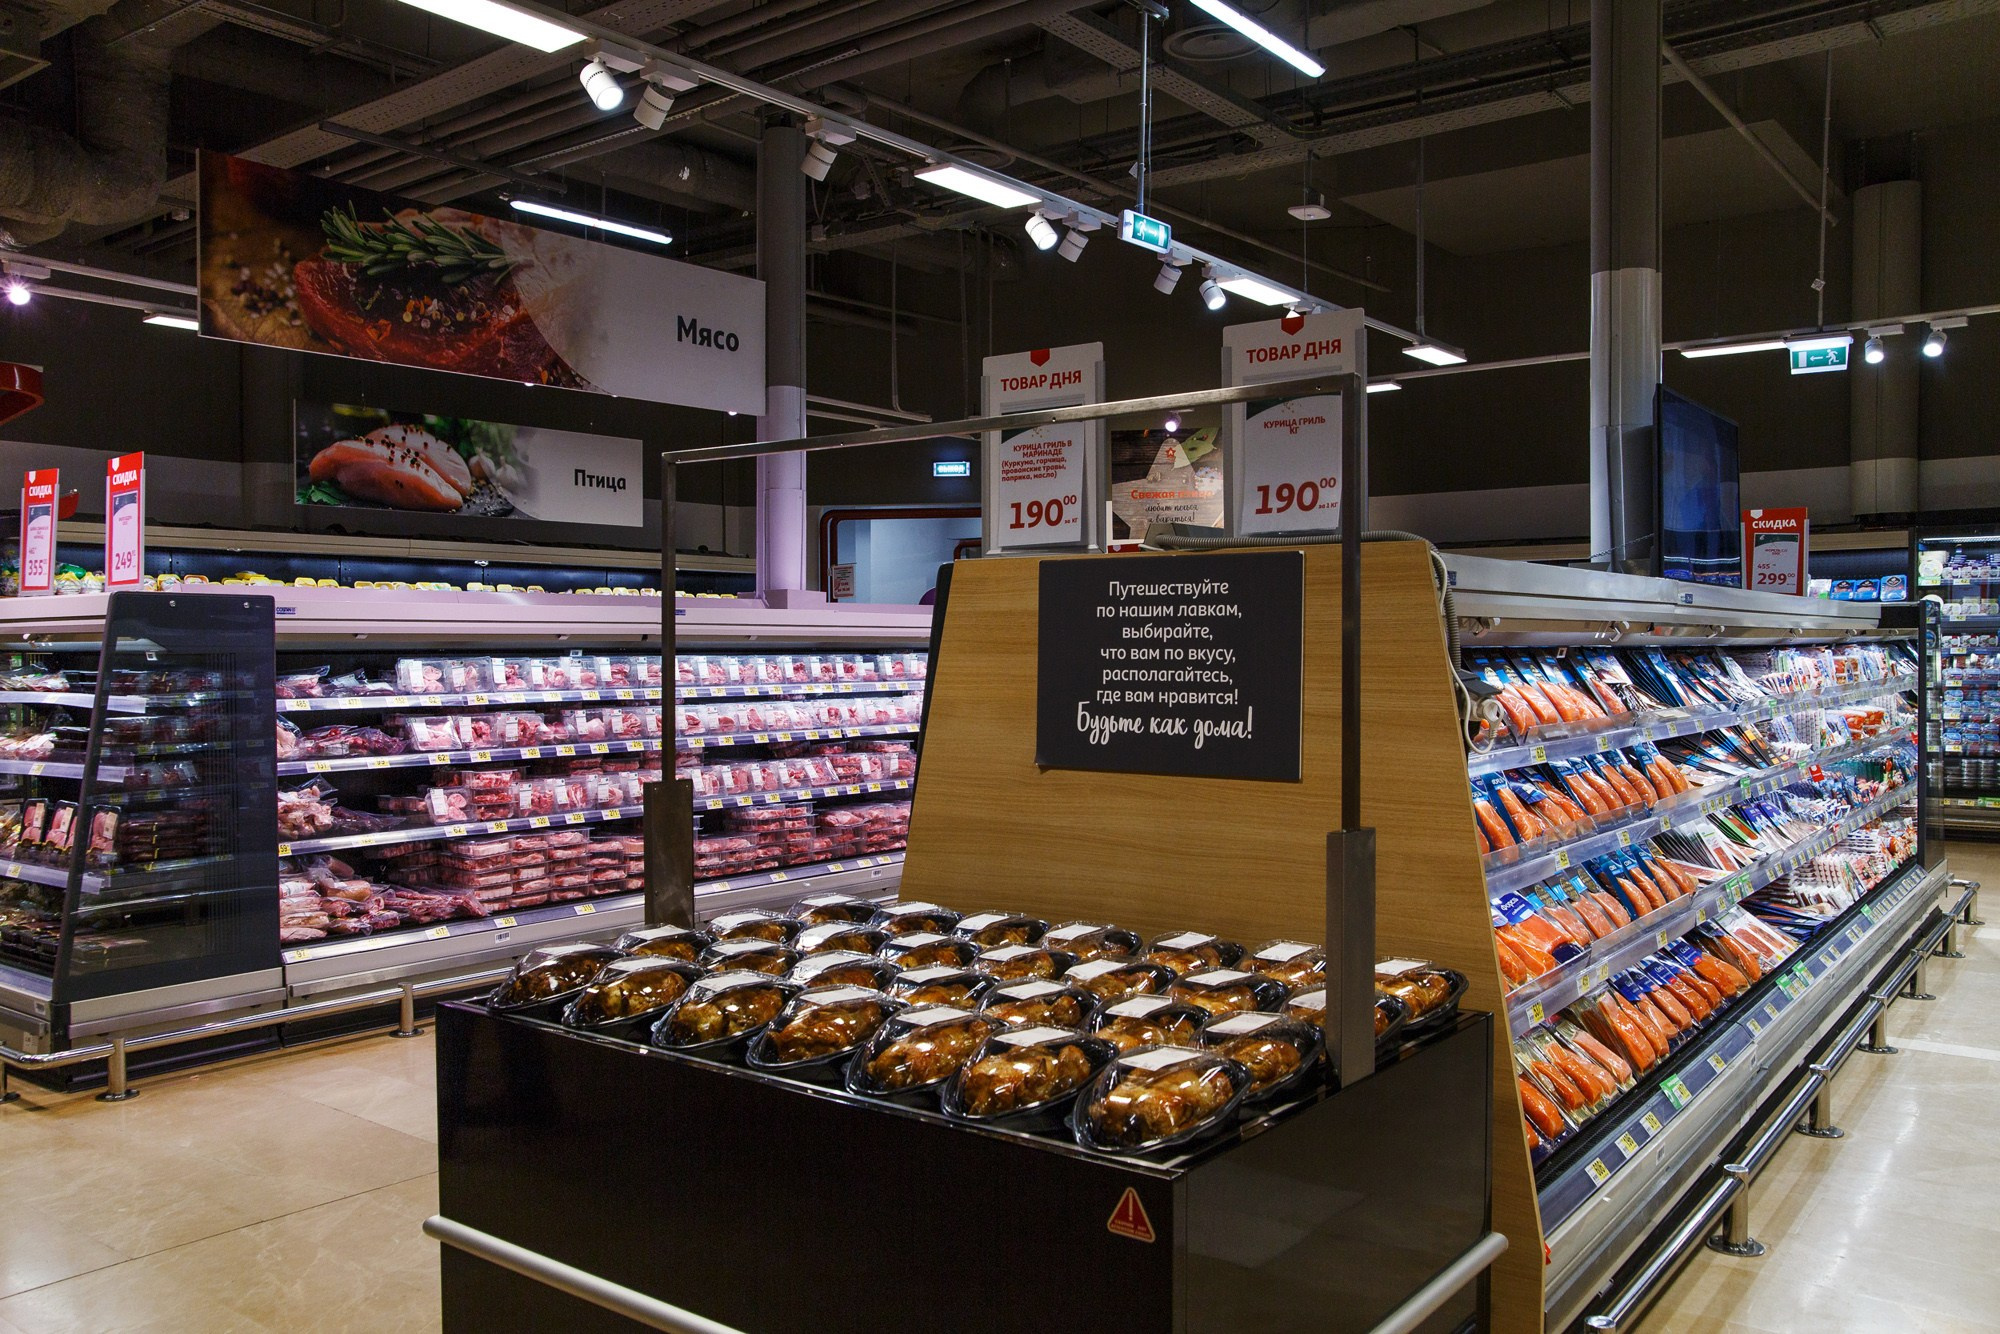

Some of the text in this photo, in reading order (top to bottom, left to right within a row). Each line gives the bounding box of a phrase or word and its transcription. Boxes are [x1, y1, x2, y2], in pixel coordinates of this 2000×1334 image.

[677, 315, 739, 352] Мясо
[1246, 339, 1342, 364] ТОВАР ДНЯ
[1001, 370, 1082, 391] ТОВАР ДНЯ
[1263, 415, 1326, 429] КУРИЦА ГРИЛЬ
[1013, 443, 1043, 452] КУРИЦА
[1043, 441, 1067, 450] ГРИЛЬ
[1022, 449, 1063, 459] МАРИНАДЕ
[112, 470, 137, 485] СКИДКА
[574, 468, 627, 492] Птица
[28, 485, 52, 498] СКИДКА
[1131, 490, 1175, 500] Свежая
[1255, 477, 1336, 515] 190 00
[1009, 495, 1077, 529] 190 00
[1752, 519, 1797, 530] СКИДКА
[28, 559, 43, 576] 355
[115, 552, 132, 571] 249
[1757, 573, 1787, 586] 299
[1109, 579, 1229, 600] Путешествуйте
[1096, 604, 1243, 619] по нашим лавкам,
[1122, 623, 1213, 642] выбирайте,
[1100, 647, 1236, 664] что вам по вкусу,
[1102, 666, 1233, 685] располагайтесь,
[1096, 688, 1238, 707] где вам нравится!
[1076, 701, 1253, 749] Будьте как дома!
